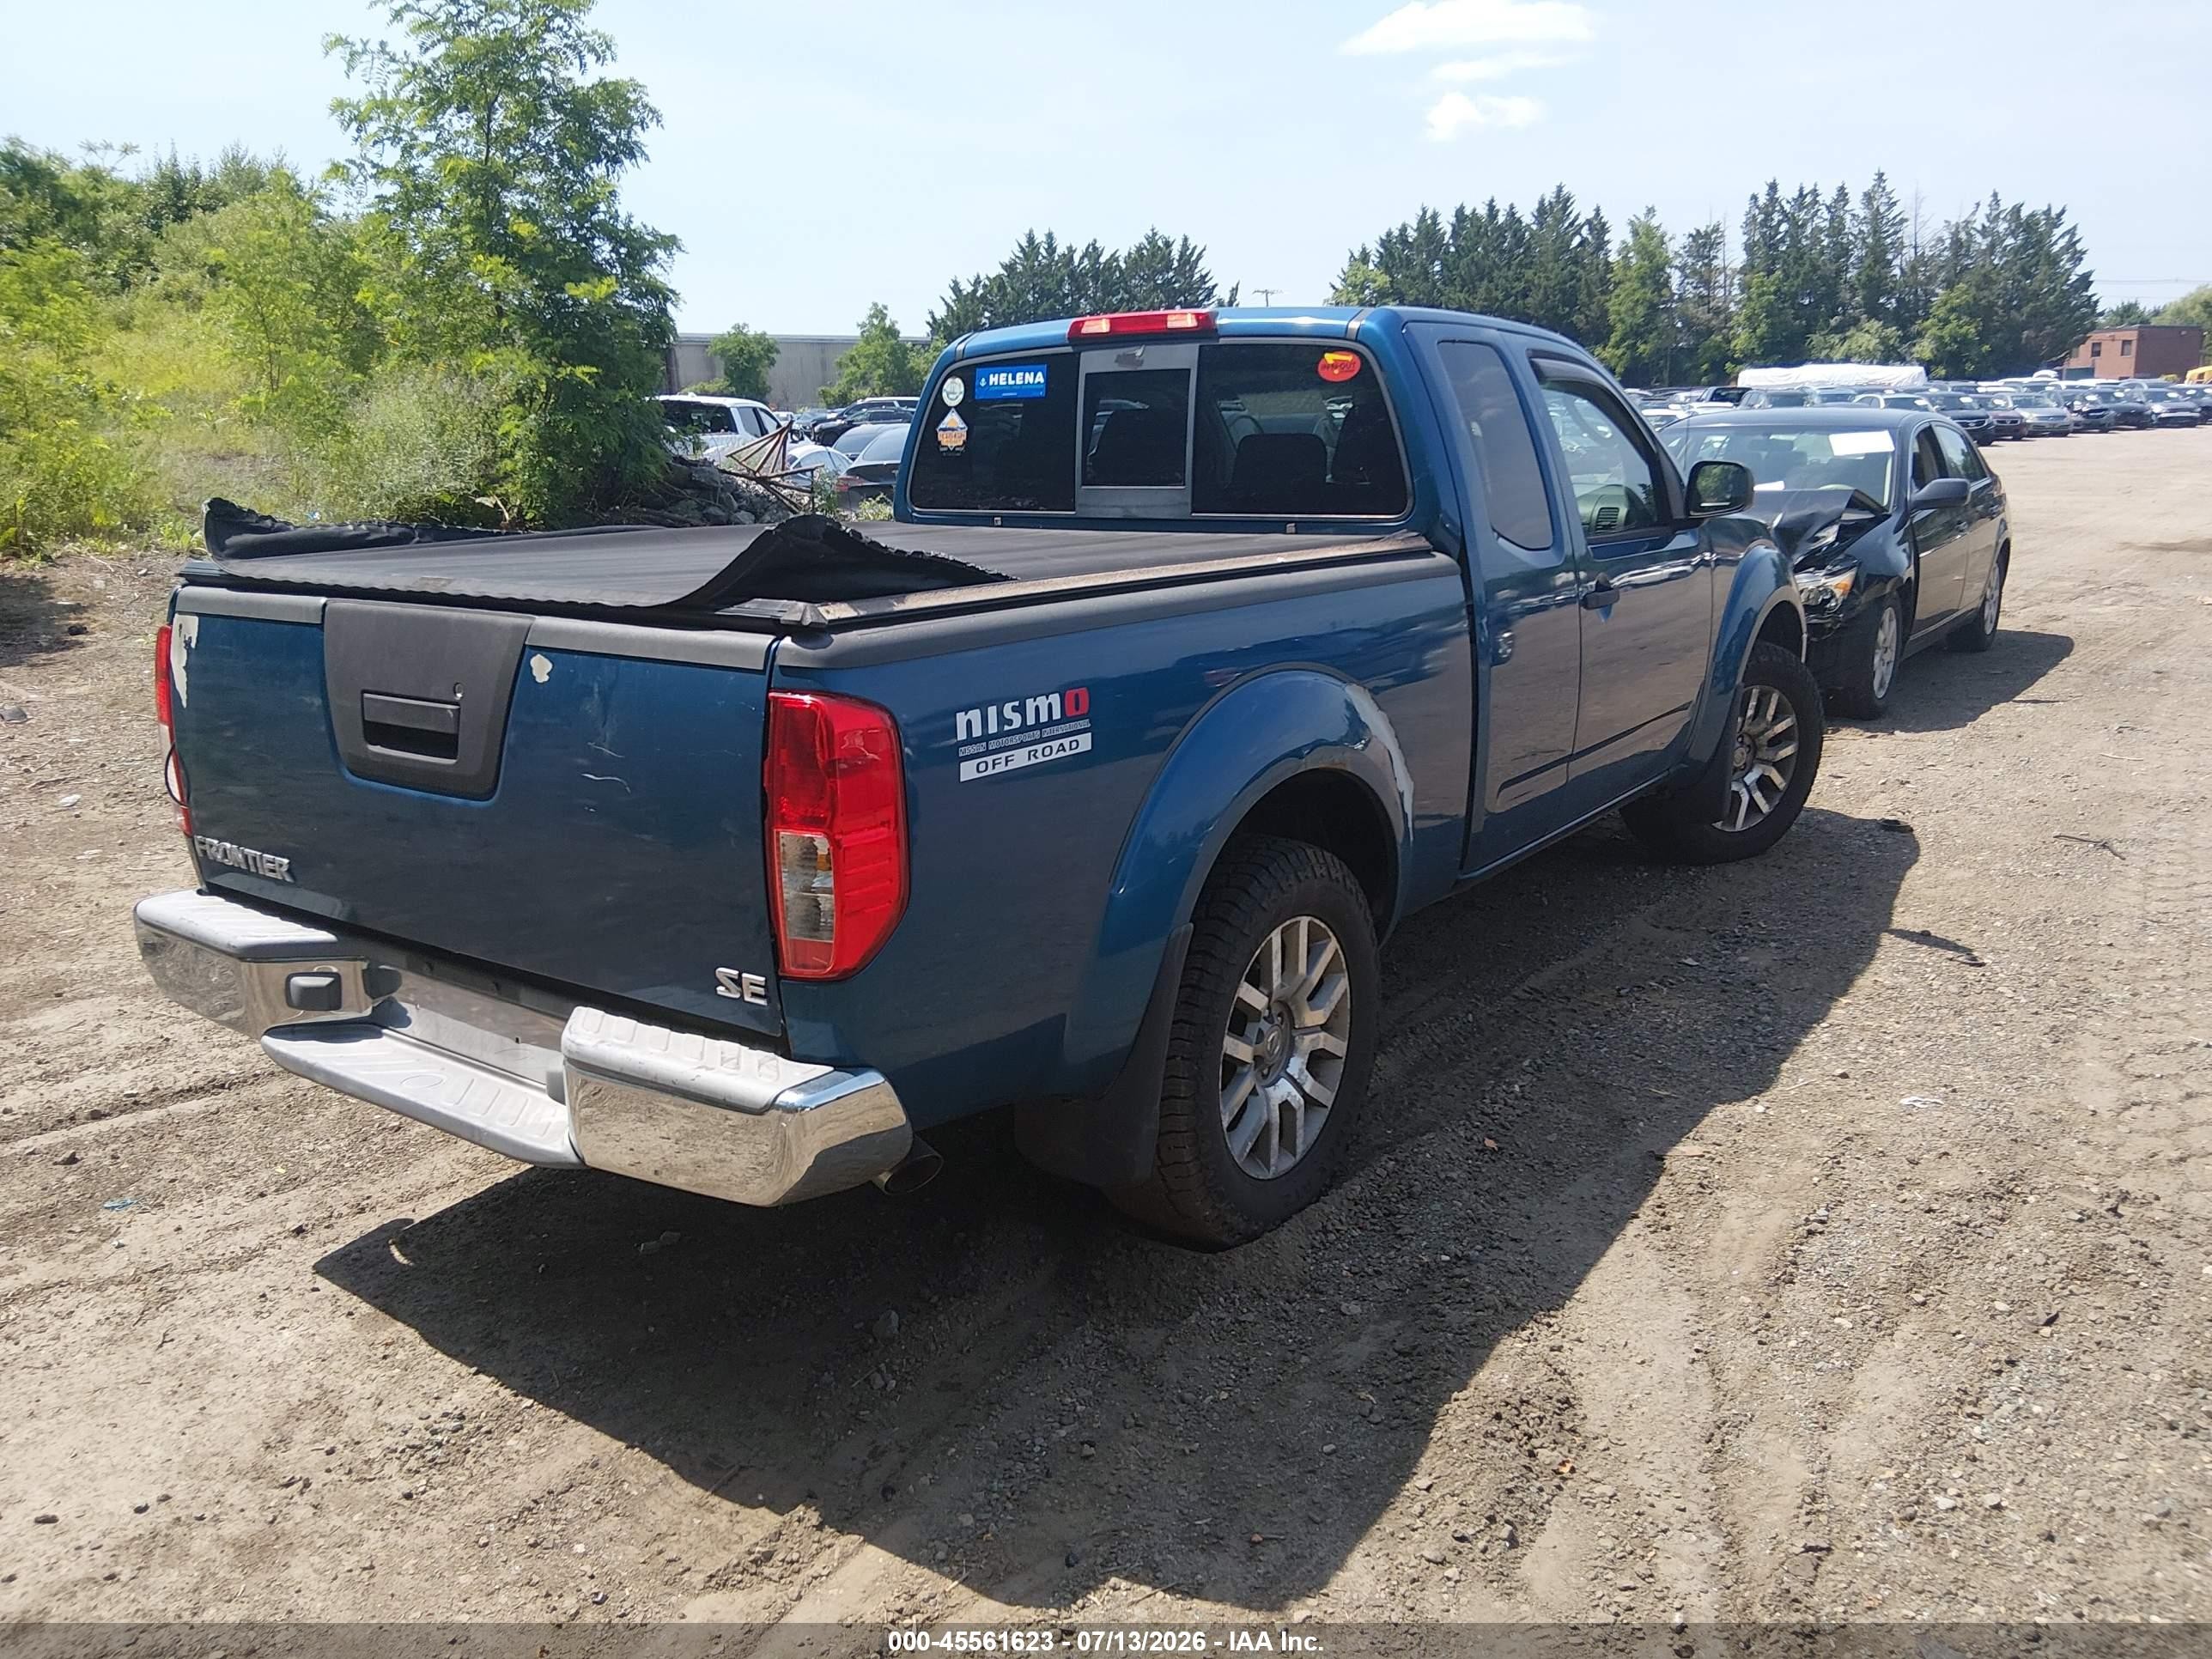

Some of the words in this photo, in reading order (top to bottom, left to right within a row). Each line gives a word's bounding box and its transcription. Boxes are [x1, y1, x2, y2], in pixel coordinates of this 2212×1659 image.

[988, 371, 1045, 386] HELENA
[958, 741, 987, 757] NISSAN
[988, 730, 1041, 750] MOTORSPORTS
[975, 754, 1015, 775] OFF
[1027, 738, 1080, 763] ROAD
[194, 835, 295, 884] FRONTIER
[714, 967, 769, 1006] SE
